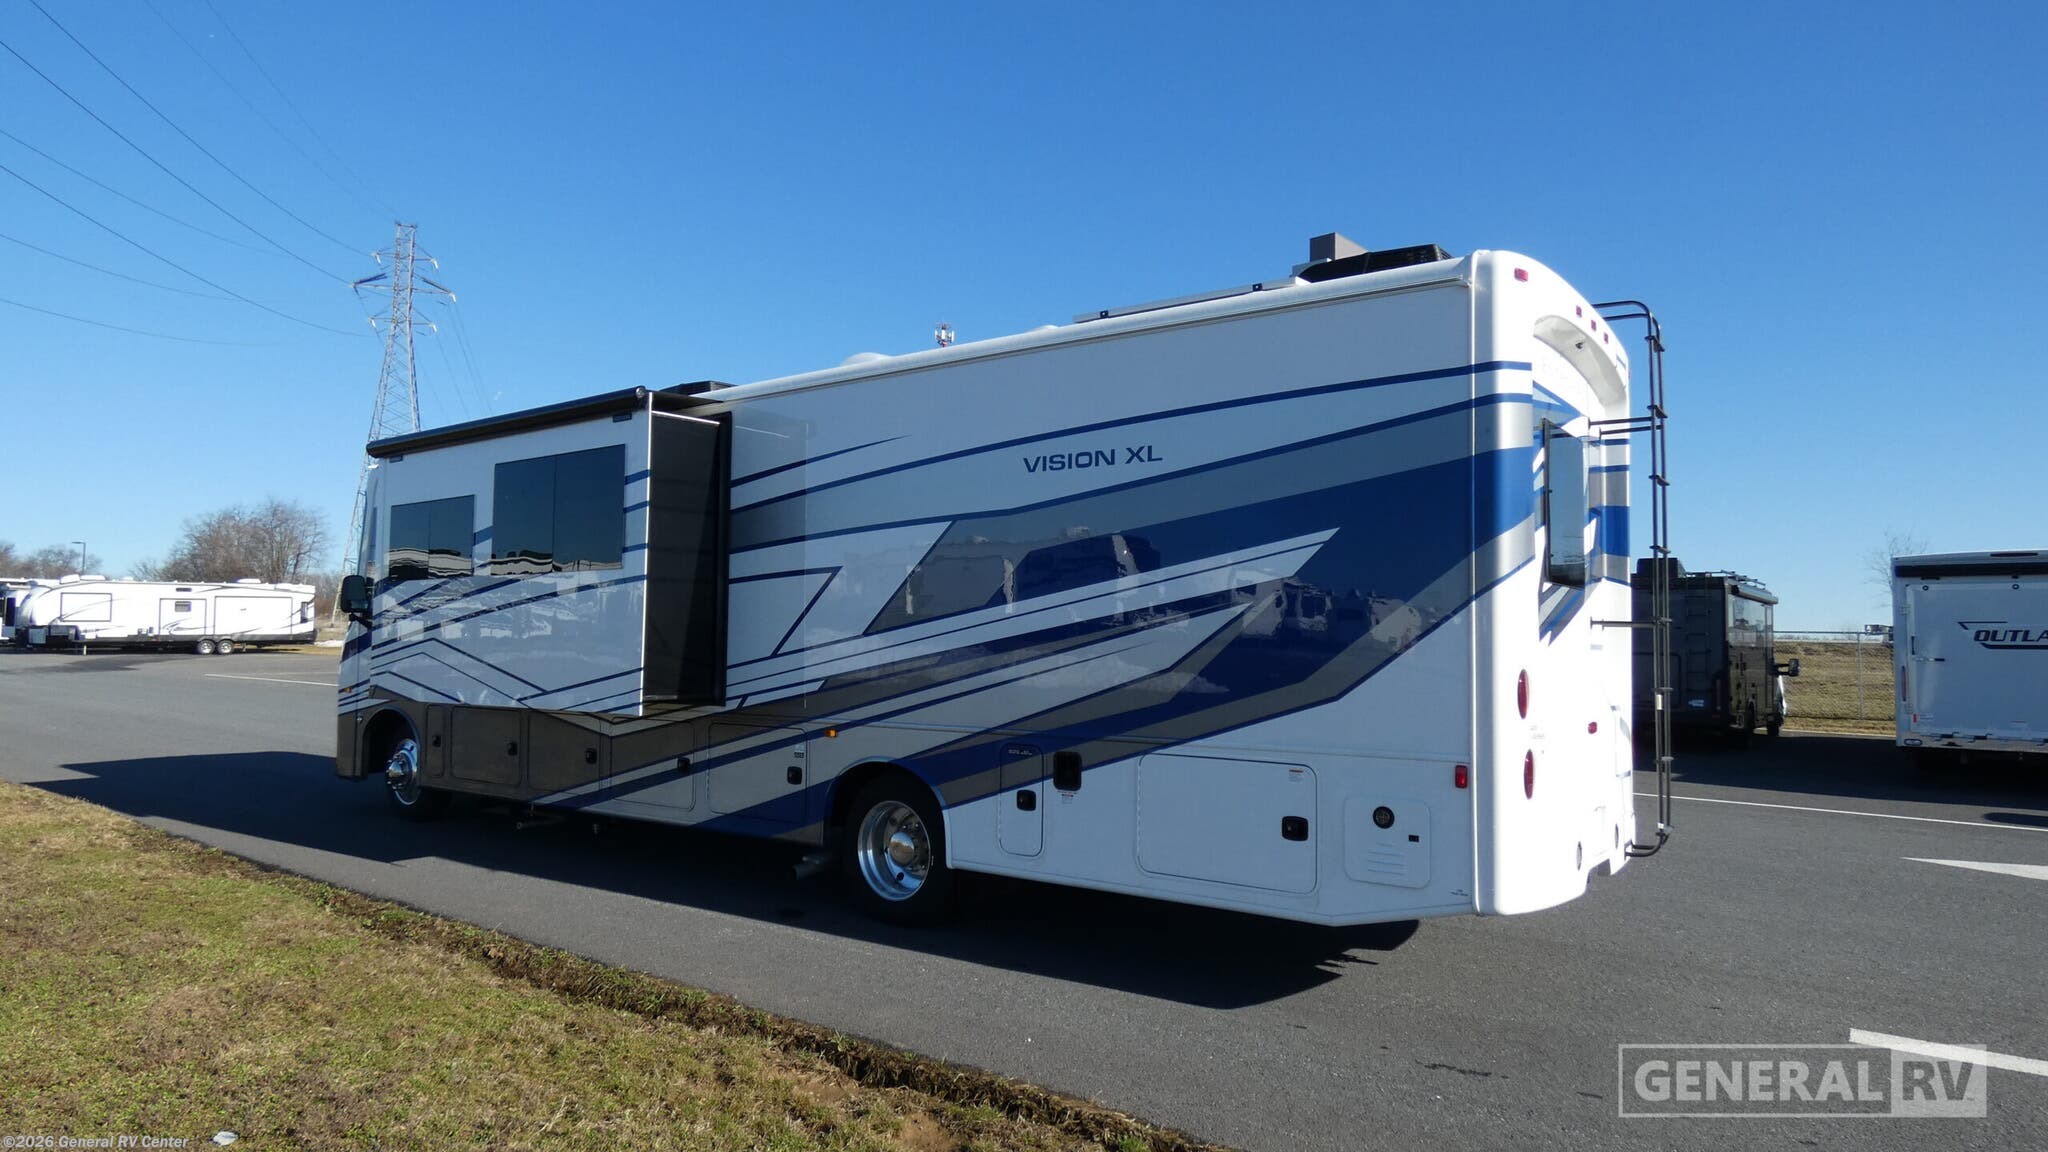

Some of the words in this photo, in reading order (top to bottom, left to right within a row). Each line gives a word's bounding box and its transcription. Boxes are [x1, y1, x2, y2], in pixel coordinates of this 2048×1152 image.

[1023, 449, 1115, 473] VISION
[1125, 445, 1163, 464] XL
[1974, 630, 2048, 642] OUTLA
